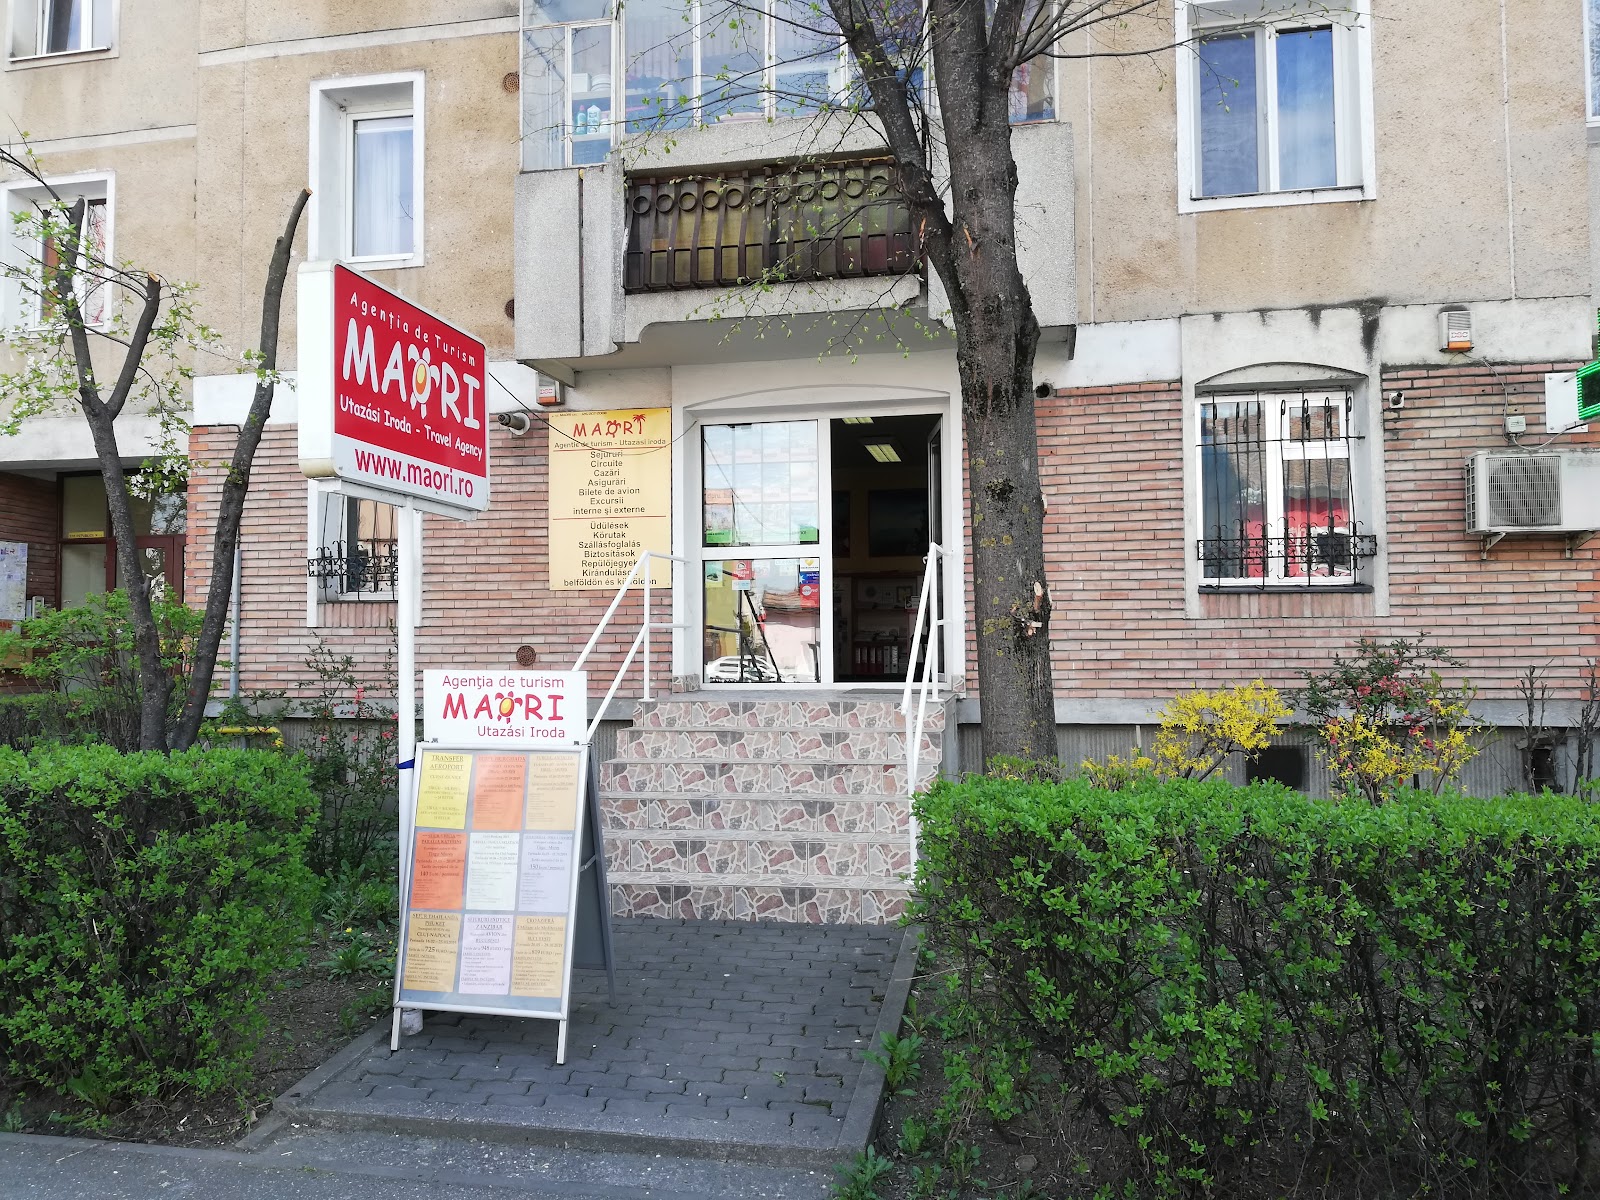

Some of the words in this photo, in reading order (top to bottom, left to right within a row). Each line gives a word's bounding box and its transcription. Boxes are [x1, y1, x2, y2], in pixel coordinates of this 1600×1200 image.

[414, 322, 429, 344] de
[434, 334, 476, 367] Turism
[342, 317, 481, 430] MAORI
[339, 394, 381, 424] Utazási
[383, 409, 412, 434] Iroda
[424, 424, 452, 448] Travel
[454, 437, 483, 462] Agency
[590, 450, 623, 460] Sejururi
[590, 460, 623, 468] Circuite
[354, 447, 474, 498] www.maori.ro
[578, 488, 603, 497] Bilete
[604, 487, 615, 496] de
[617, 487, 640, 496] avion
[590, 497, 624, 505] Excursii
[573, 507, 602, 515] interne
[614, 507, 646, 515] externe
[590, 521, 629, 530] Üdülések
[593, 531, 626, 539] Körutak
[578, 540, 641, 549] Szállásfoglalás
[563, 579, 603, 587] belföldön
[604, 578, 615, 586] és
[498, 675, 516, 688] de
[520, 675, 565, 689] turism
[442, 690, 565, 725] MAORI
[477, 724, 525, 738] Utazási
[530, 726, 566, 739] Iroda
[429, 763, 464, 771] AEROPORT
